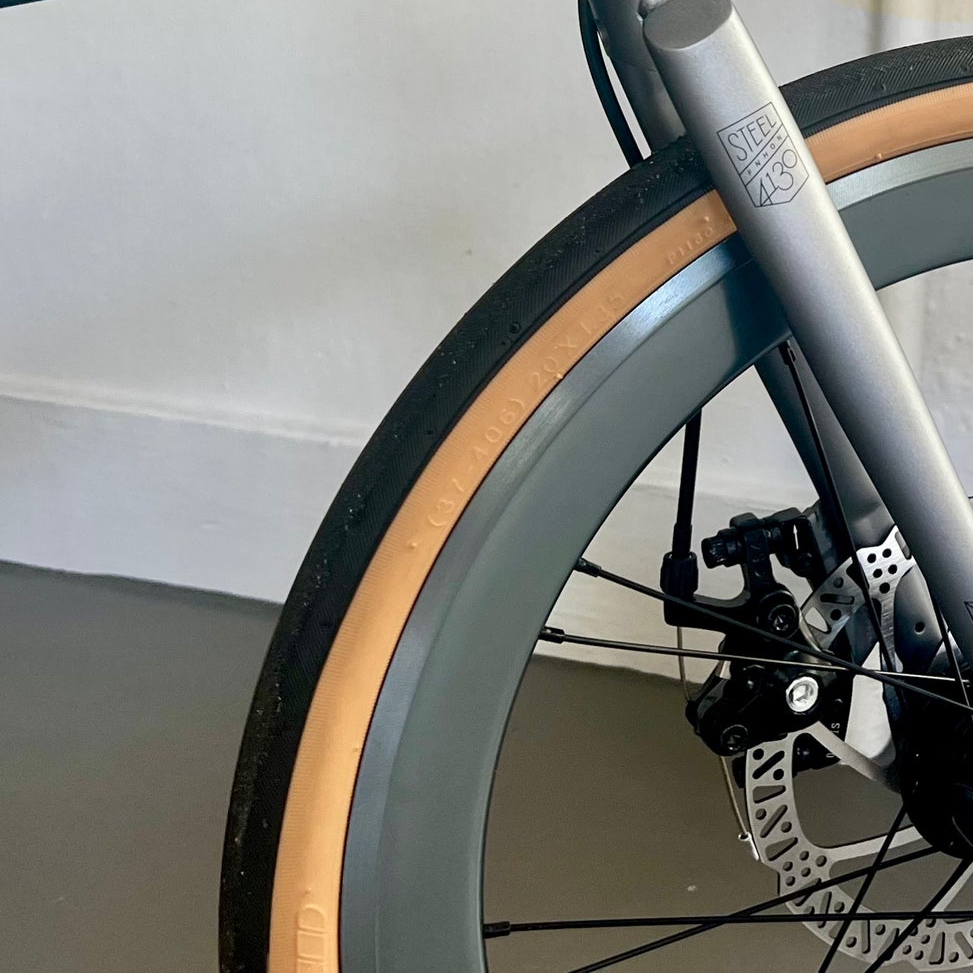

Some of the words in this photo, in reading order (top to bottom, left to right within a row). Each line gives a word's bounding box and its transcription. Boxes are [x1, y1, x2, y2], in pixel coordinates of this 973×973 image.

[727, 114, 777, 162] STEEL
[748, 134, 783, 176] FNHON
[759, 148, 798, 207] 4130
